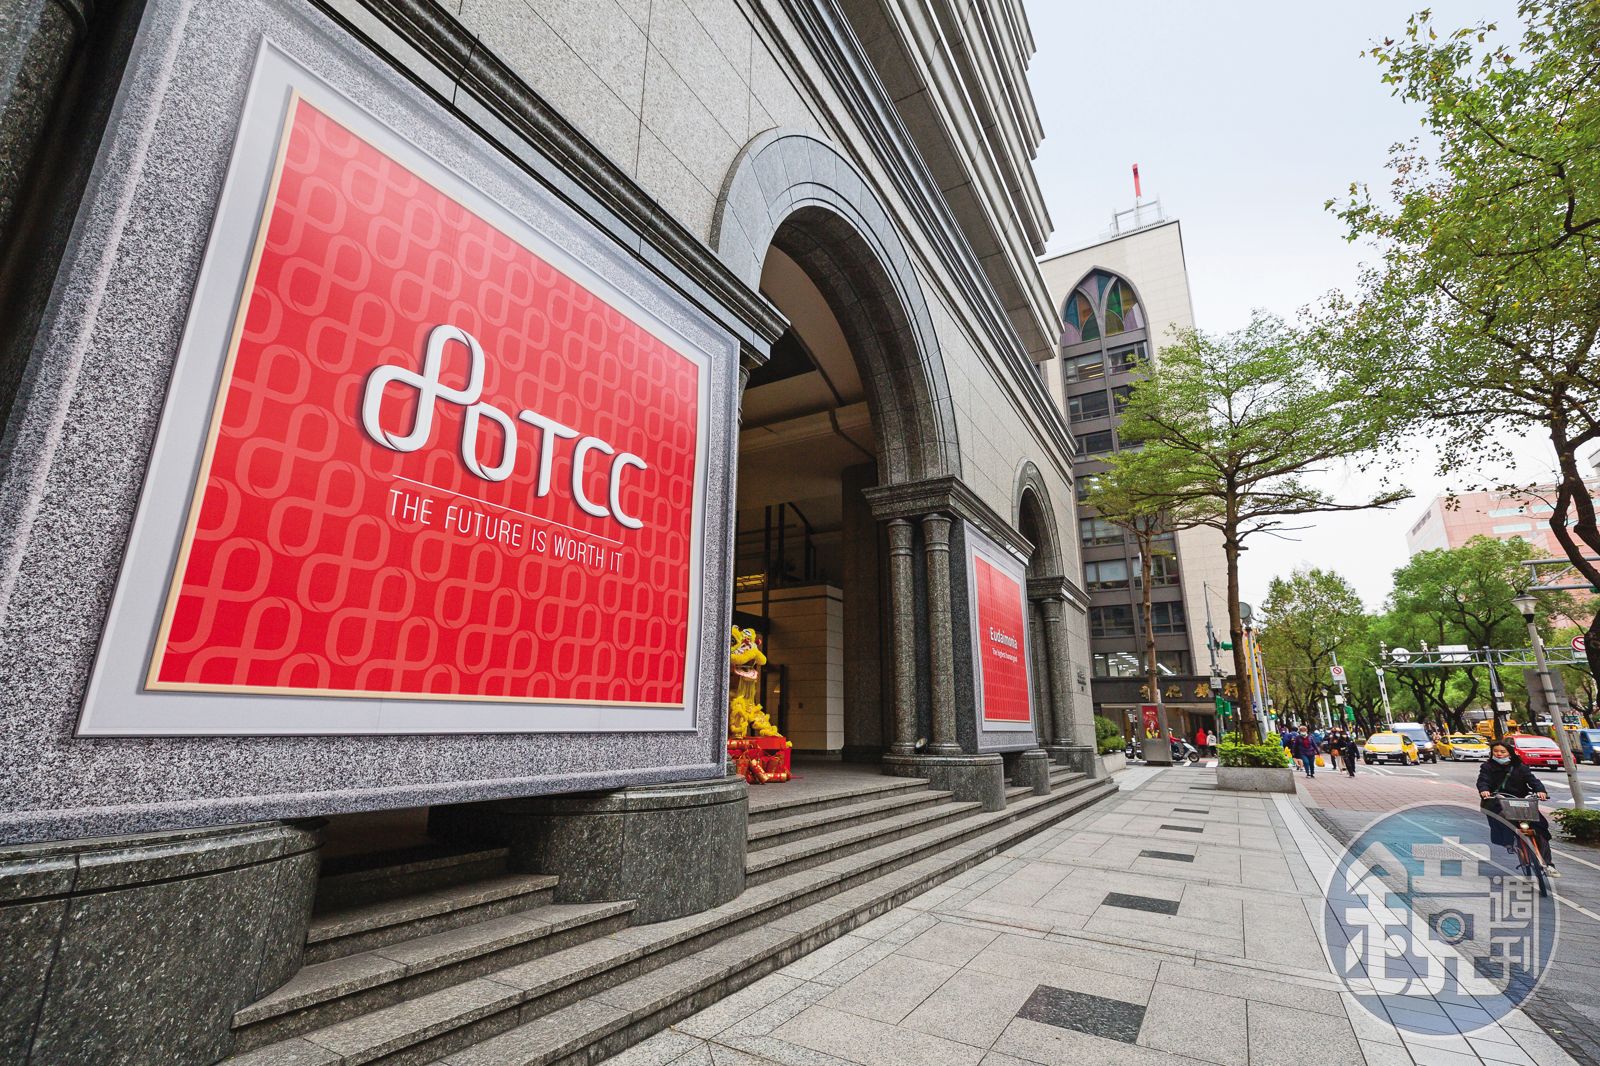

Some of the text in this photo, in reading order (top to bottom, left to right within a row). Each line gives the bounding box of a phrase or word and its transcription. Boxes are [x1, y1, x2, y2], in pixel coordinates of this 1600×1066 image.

[518, 409, 648, 530] TCC
[389, 488, 623, 573] THE FUTURE IS WORTH IT
